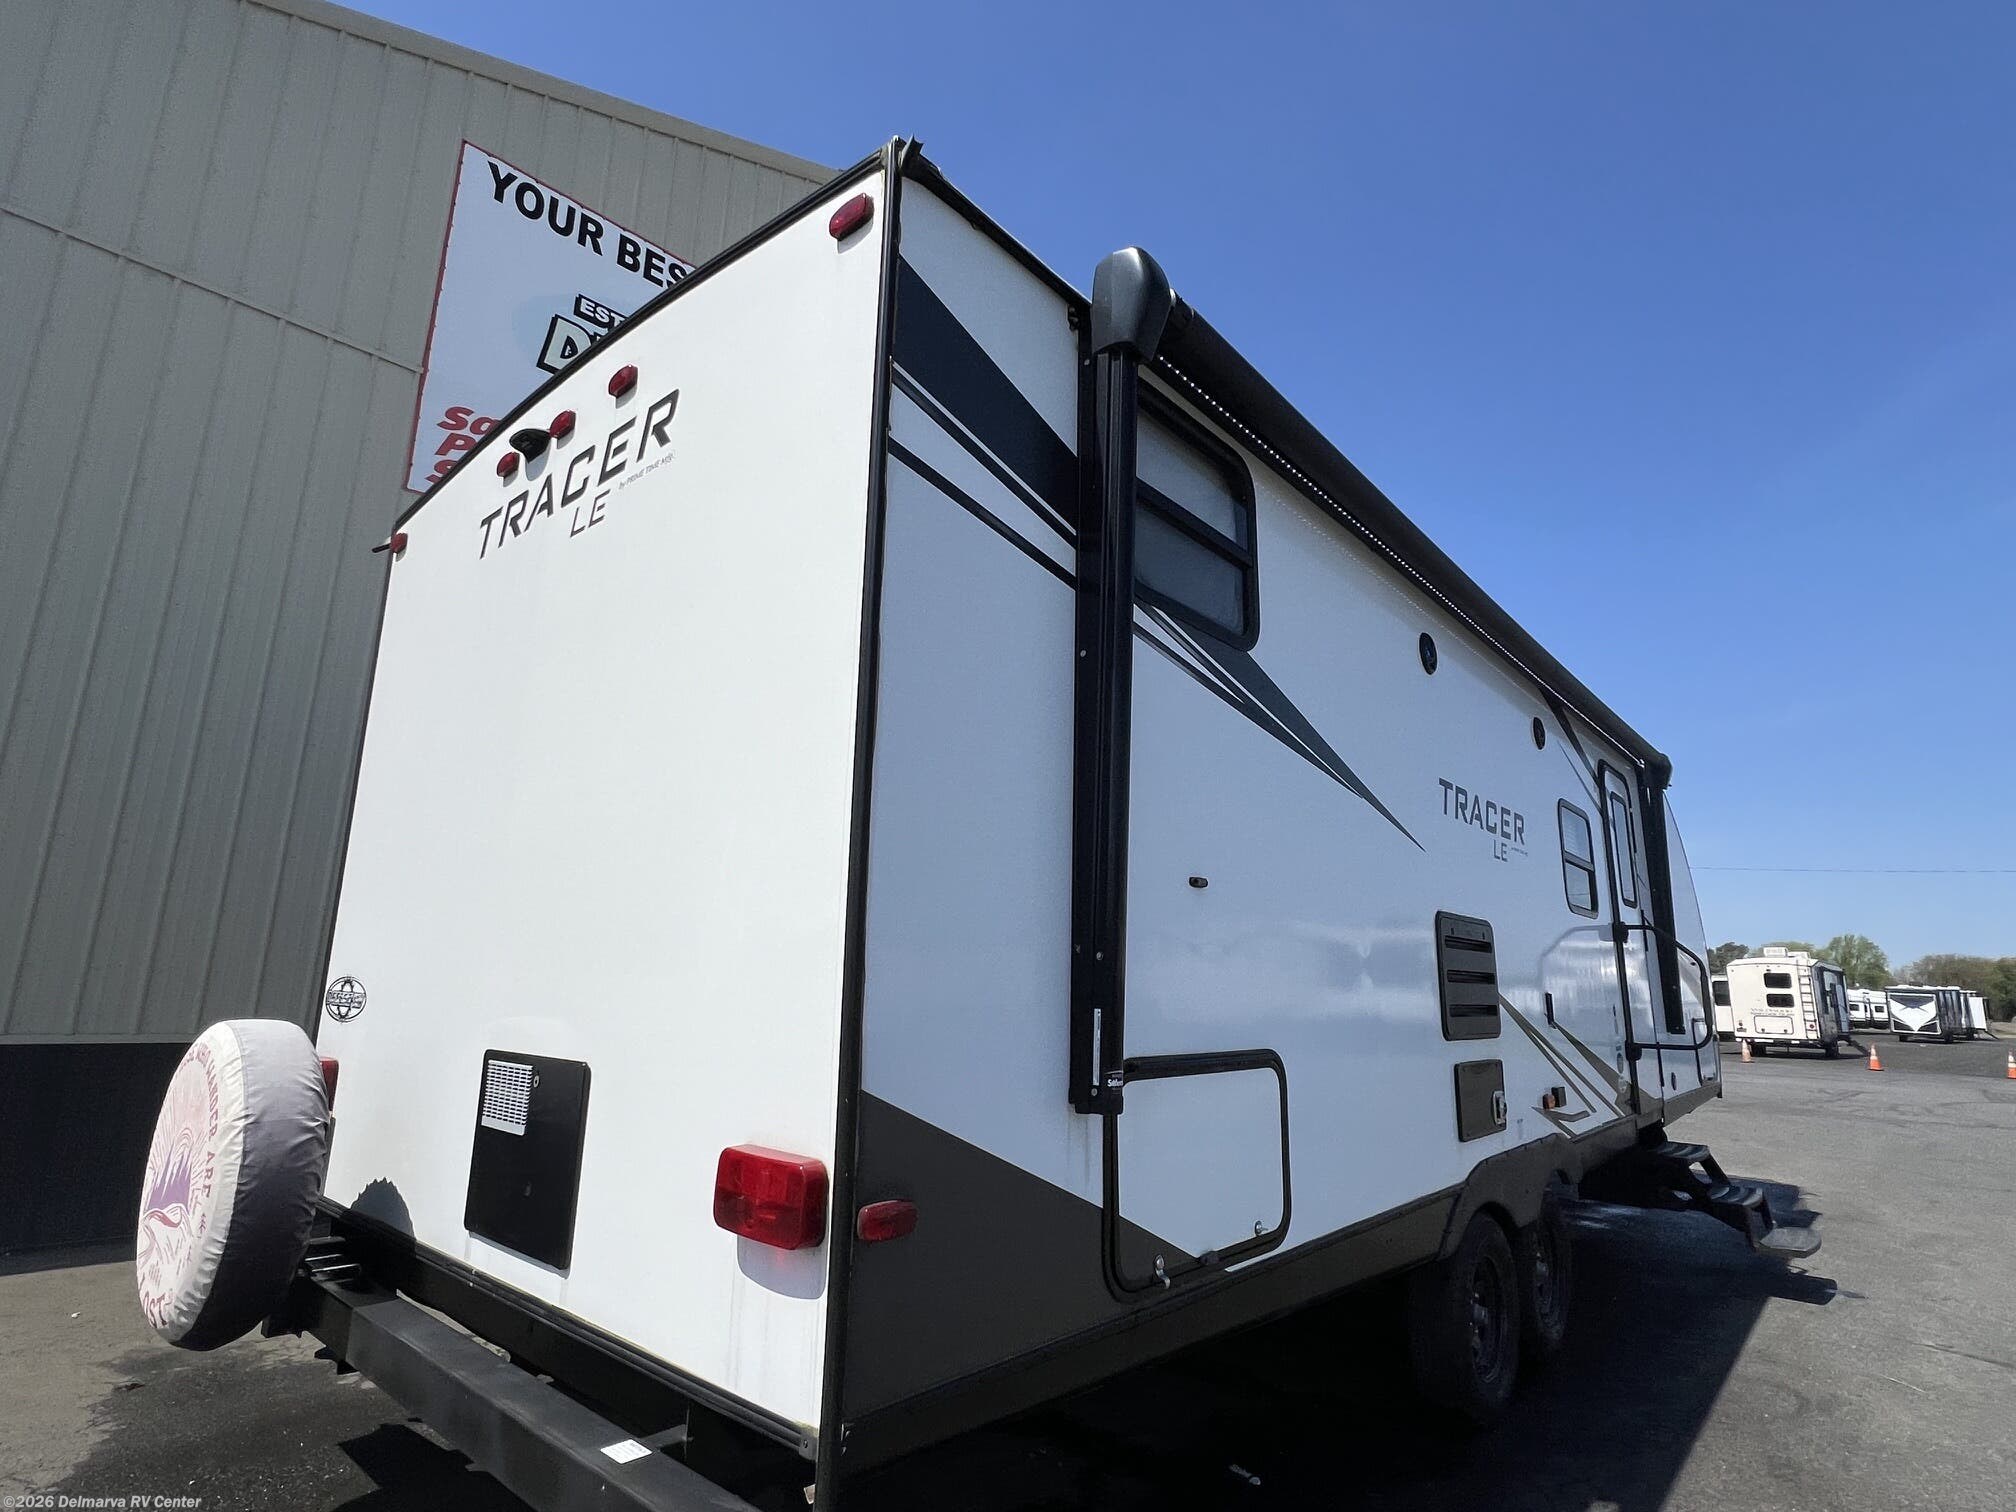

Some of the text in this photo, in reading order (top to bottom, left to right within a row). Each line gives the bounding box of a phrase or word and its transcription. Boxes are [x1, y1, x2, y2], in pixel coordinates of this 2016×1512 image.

[487, 160, 604, 256] YOUR
[479, 388, 679, 560] TRACER
[570, 488, 611, 538] LE
[1439, 777, 1525, 846] TRACER
[1493, 839, 1508, 862] LE
